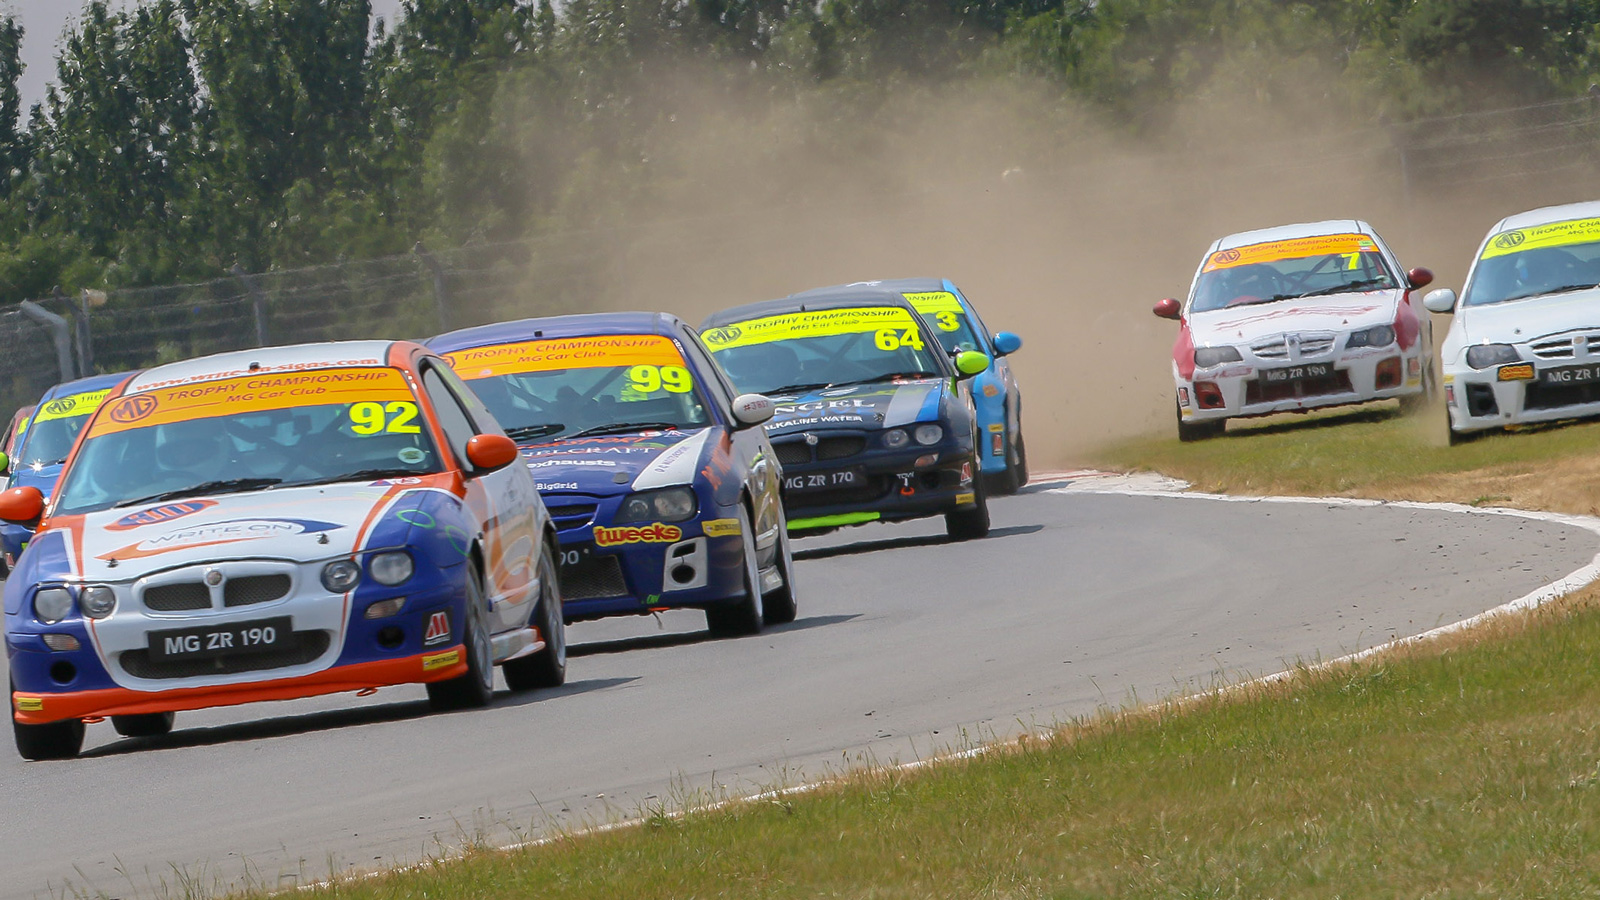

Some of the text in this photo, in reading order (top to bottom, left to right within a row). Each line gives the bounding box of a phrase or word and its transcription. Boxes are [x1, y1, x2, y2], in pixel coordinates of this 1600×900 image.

[1215, 250, 1239, 264] MG
[1341, 252, 1359, 270] 7
[748, 310, 899, 331] TROPHY CHAMPIONSHIP
[935, 311, 960, 332] 3
[707, 327, 740, 345] MG
[874, 328, 924, 351] 64
[464, 347, 528, 361] TROPHY
[536, 339, 662, 352] CHAMPIONSHIP
[517, 350, 606, 363] MG Car Club
[630, 365, 693, 393] 99
[1289, 367, 1303, 379] ZR
[1548, 370, 1571, 382] MG
[1574, 369, 1592, 380] ZR
[167, 372, 388, 401] TROPHY CHAMPIONSHIP
[225, 387, 327, 402] MG Car Club
[114, 397, 153, 421] MG
[773, 399, 876, 415] NGEL
[349, 401, 421, 435] 92
[526, 459, 617, 469] exhausts
[534, 482, 578, 491] BigGrid
[807, 474, 826, 487] ZR
[832, 471, 854, 485] 170
[150, 526, 244, 544] WRITE
[595, 525, 682, 545] tweeks
[164, 626, 276, 655] MG ZR 190
